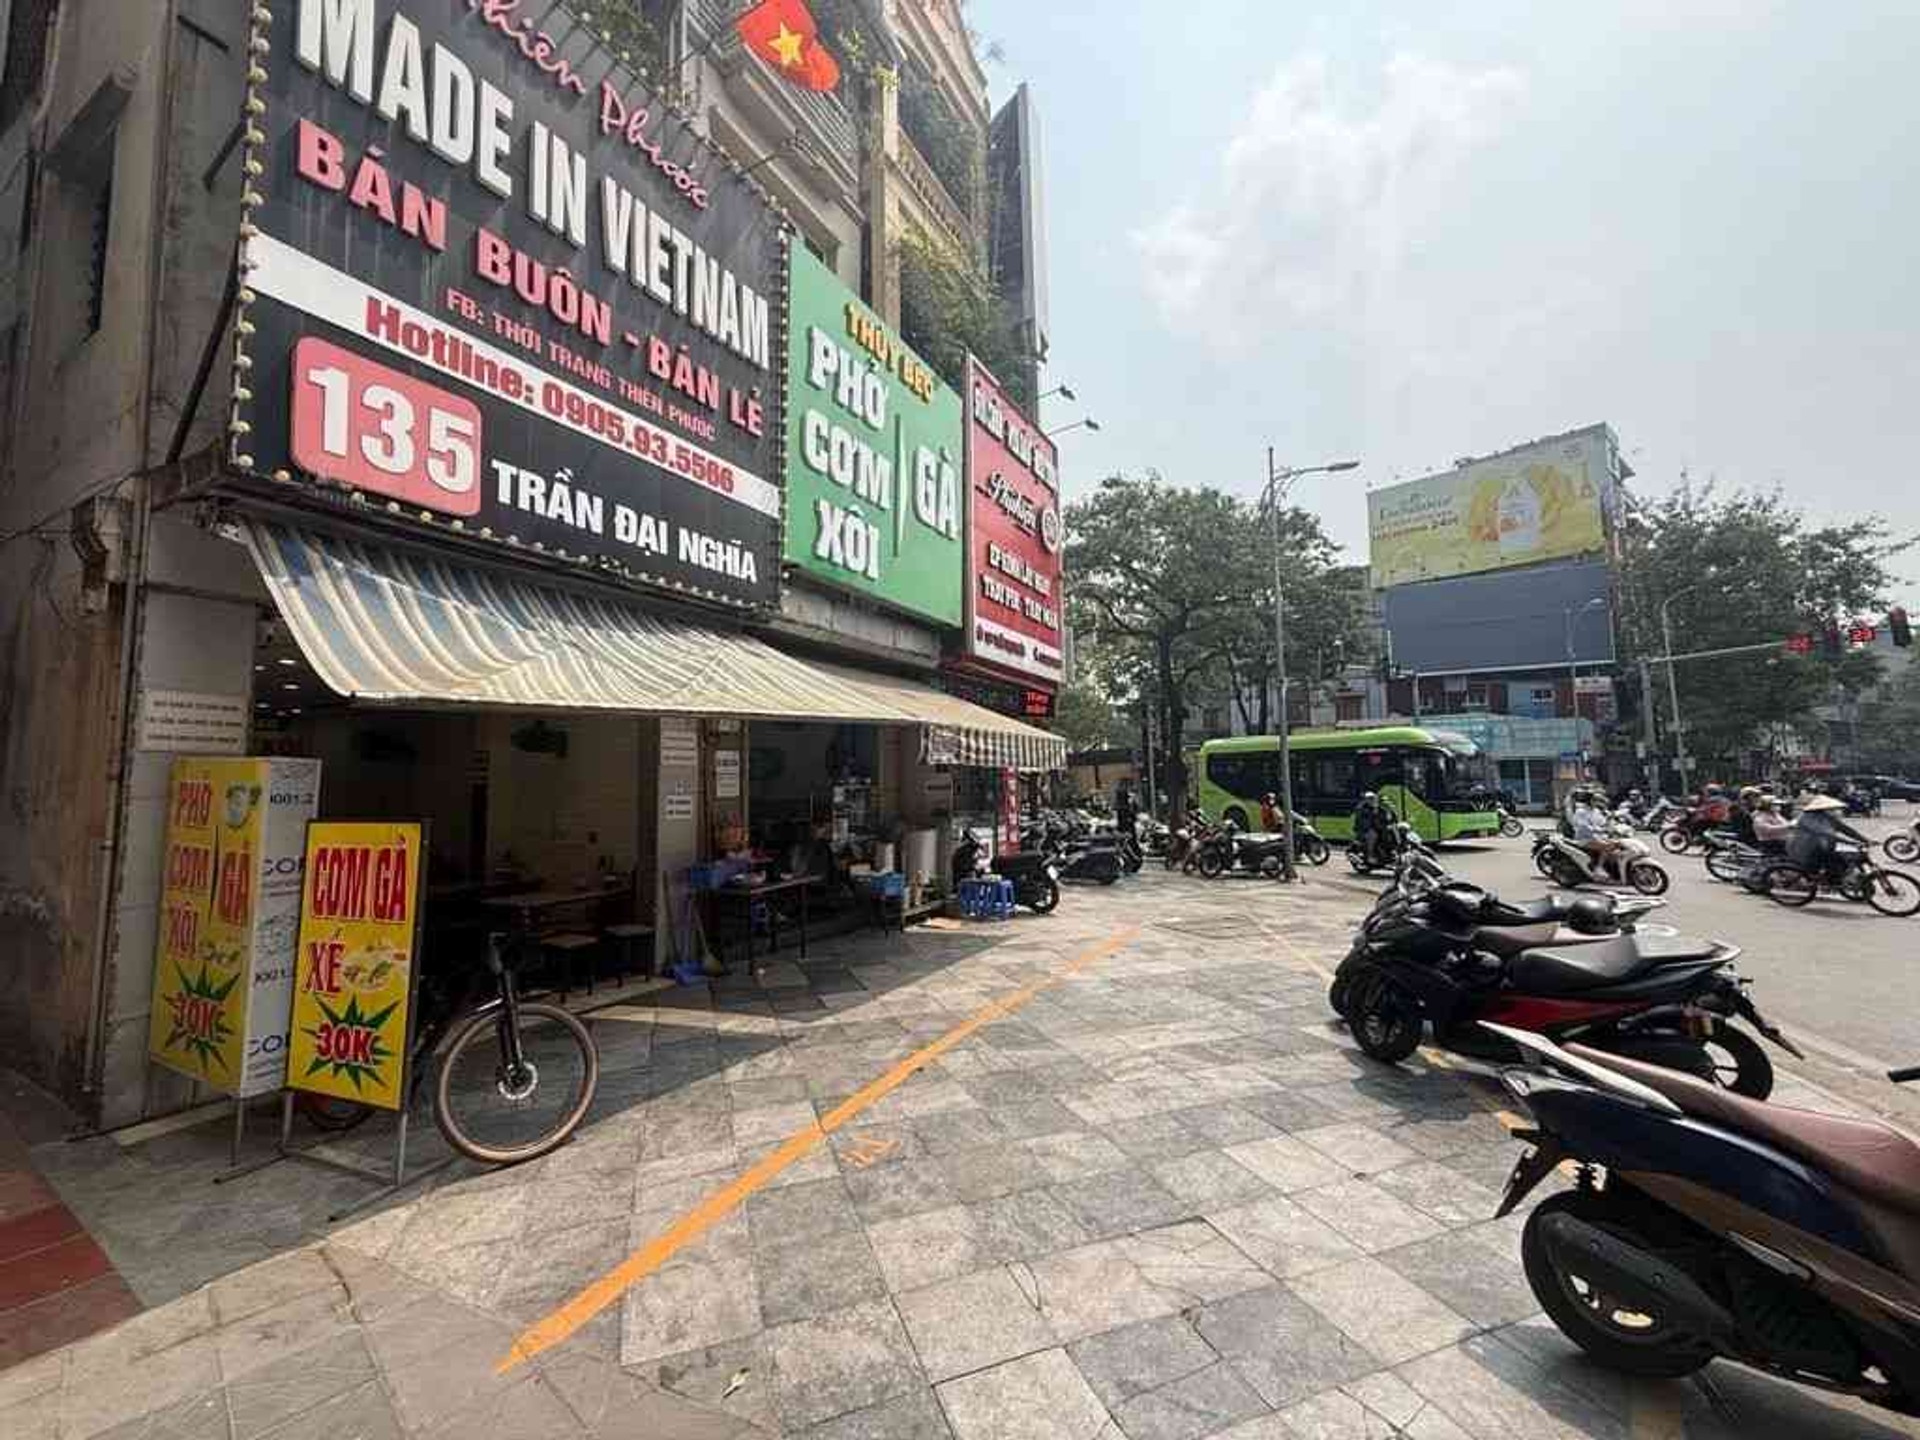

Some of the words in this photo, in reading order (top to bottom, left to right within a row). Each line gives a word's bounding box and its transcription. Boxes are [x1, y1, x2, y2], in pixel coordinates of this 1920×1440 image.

[295, 0, 514, 198] MADE
[527, 120, 588, 250] IN
[598, 175, 770, 373] VIETNAM
[296, 117, 447, 252] BÁN
[476, 226, 612, 348] BUÔN
[648, 333, 721, 414] BÁN
[364, 296, 537, 402] Hotline:
[445, 287, 485, 327] FB:
[548, 339, 614, 391] TRANG
[808, 324, 890, 431] PHỞ
[307, 365, 477, 495] 135
[802, 406, 892, 512] CƠM
[492, 458, 604, 535] TRẦN
[613, 503, 670, 557] ĐẠI
[677, 526, 758, 584] NGHĨA
[813, 498, 881, 581] XÔI
[913, 444, 960, 541] GÀ
[316, 1020, 375, 1067] 30K
